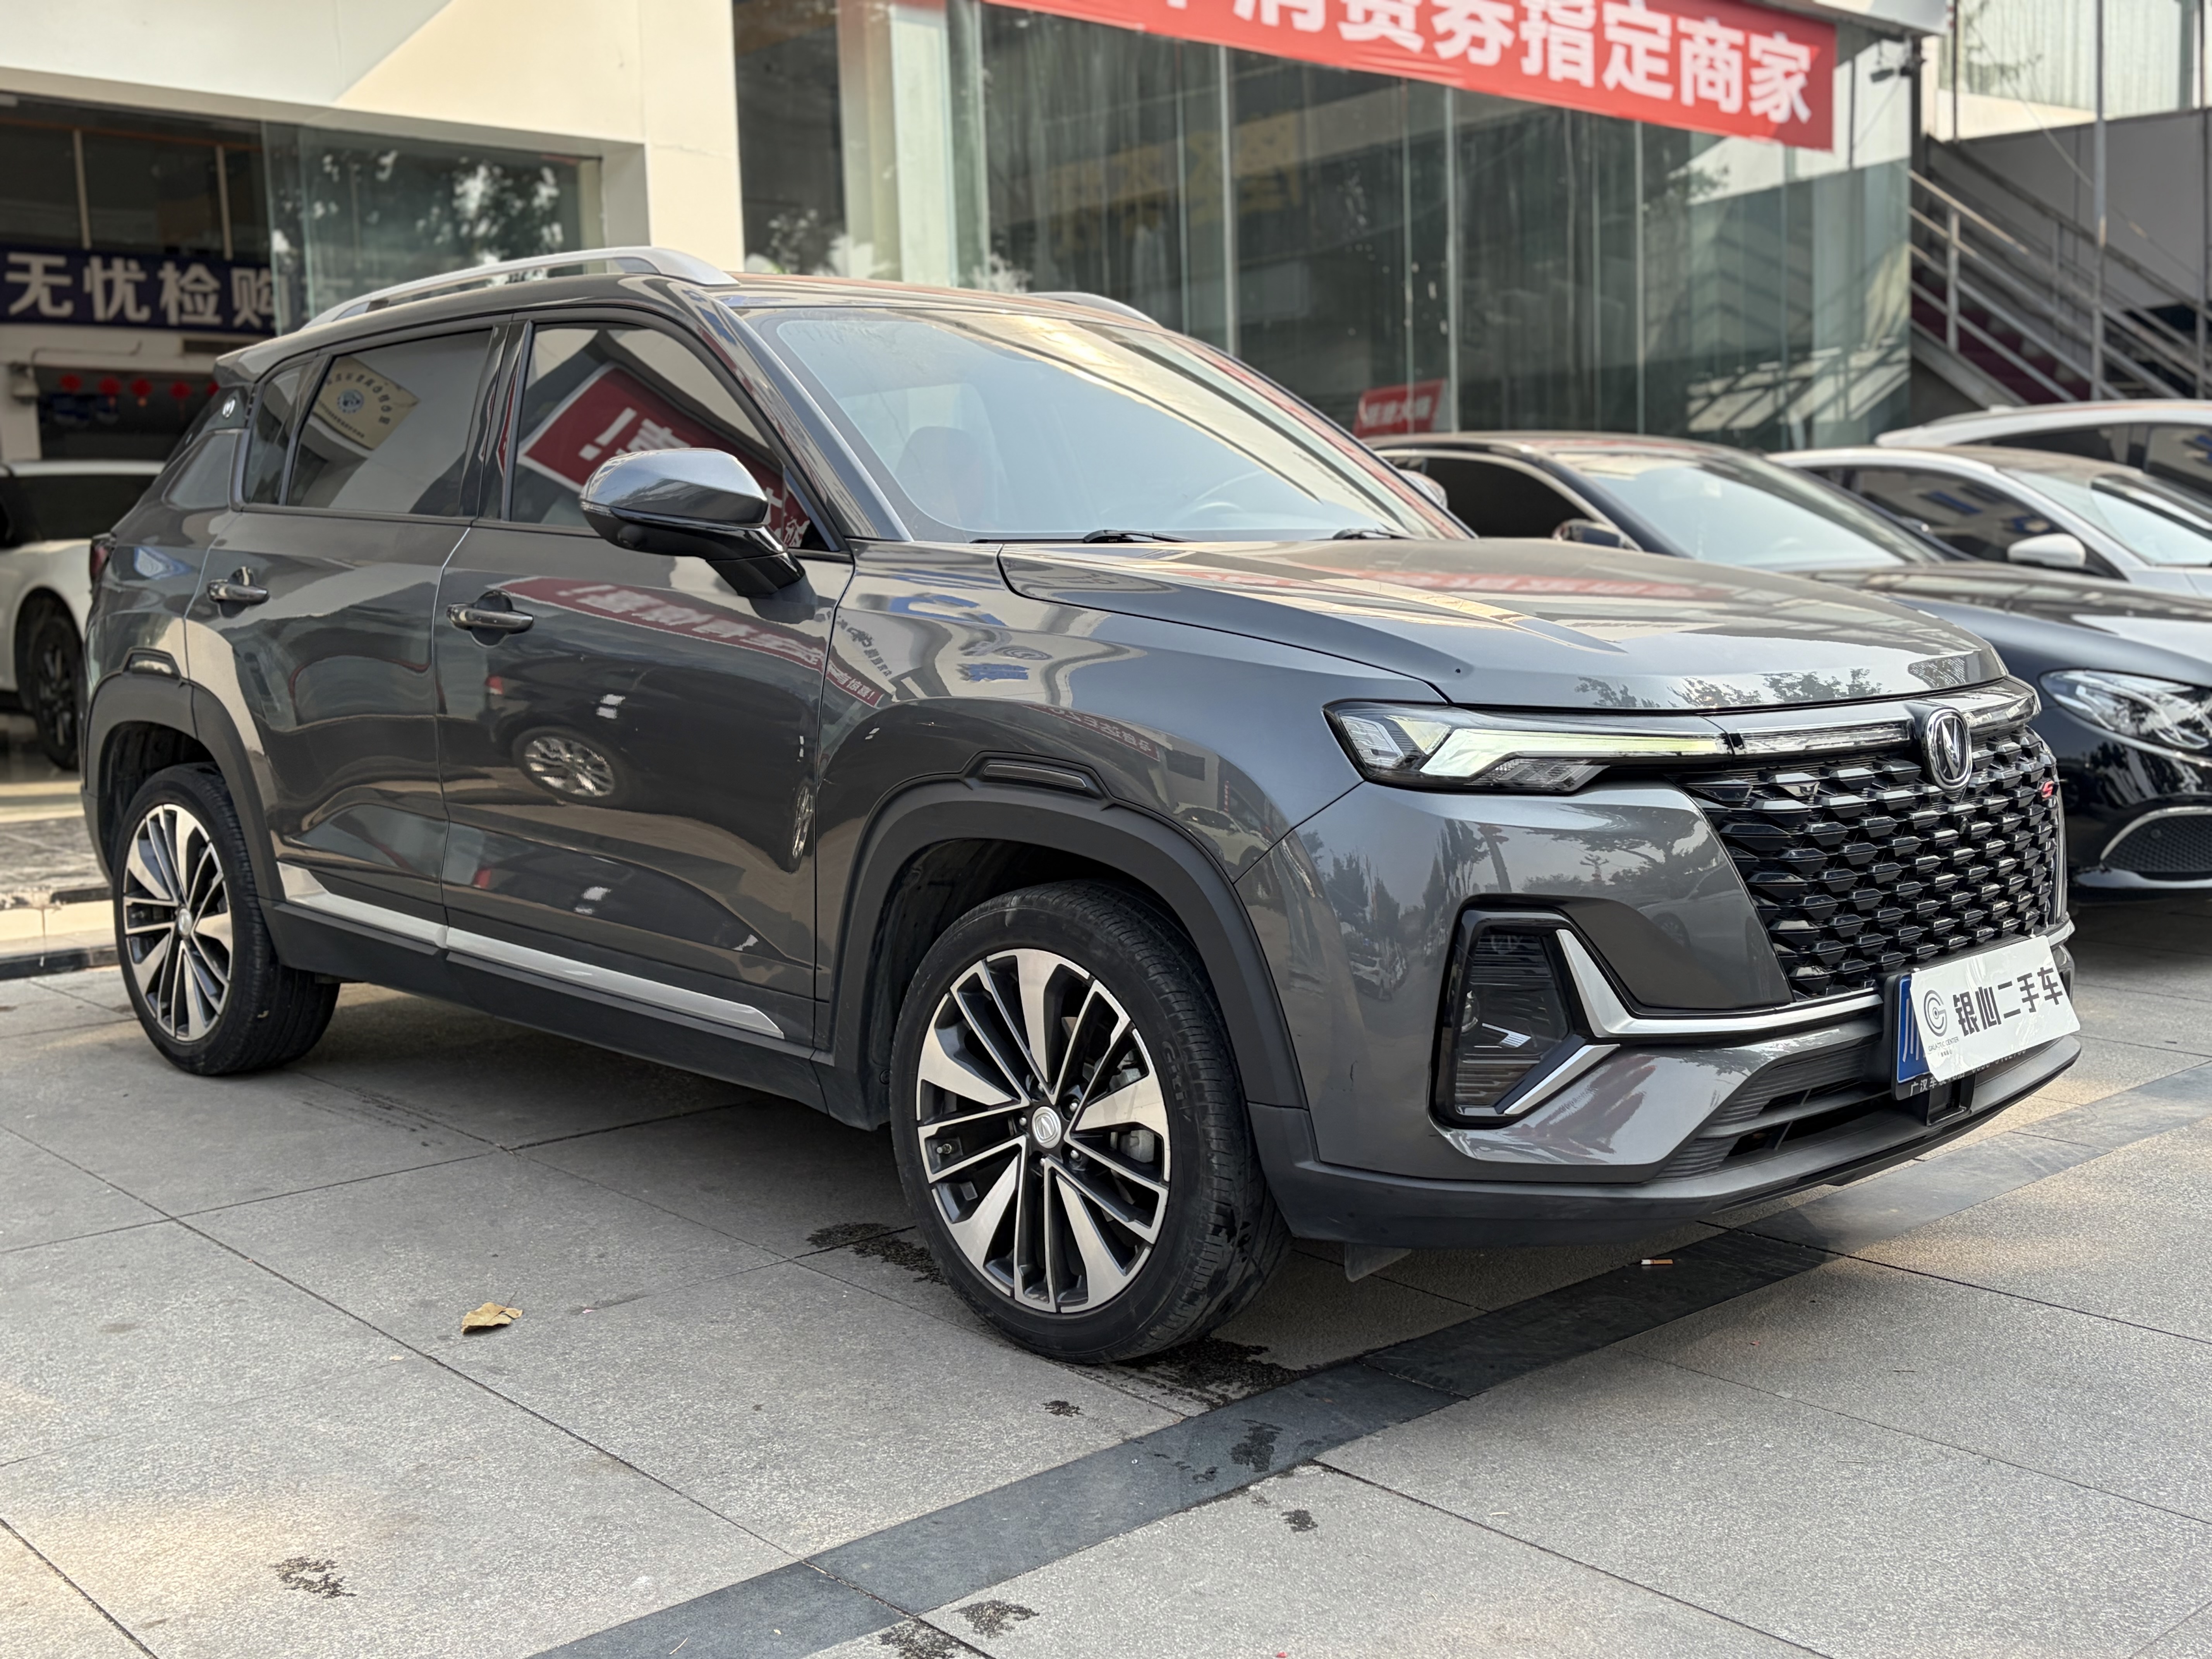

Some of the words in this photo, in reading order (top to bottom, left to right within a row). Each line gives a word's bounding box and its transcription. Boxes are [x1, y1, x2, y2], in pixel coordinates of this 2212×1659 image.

[1167, 0, 1812, 124] 费券指定商家
[1953, 967, 2063, 1037] 银心二手车
